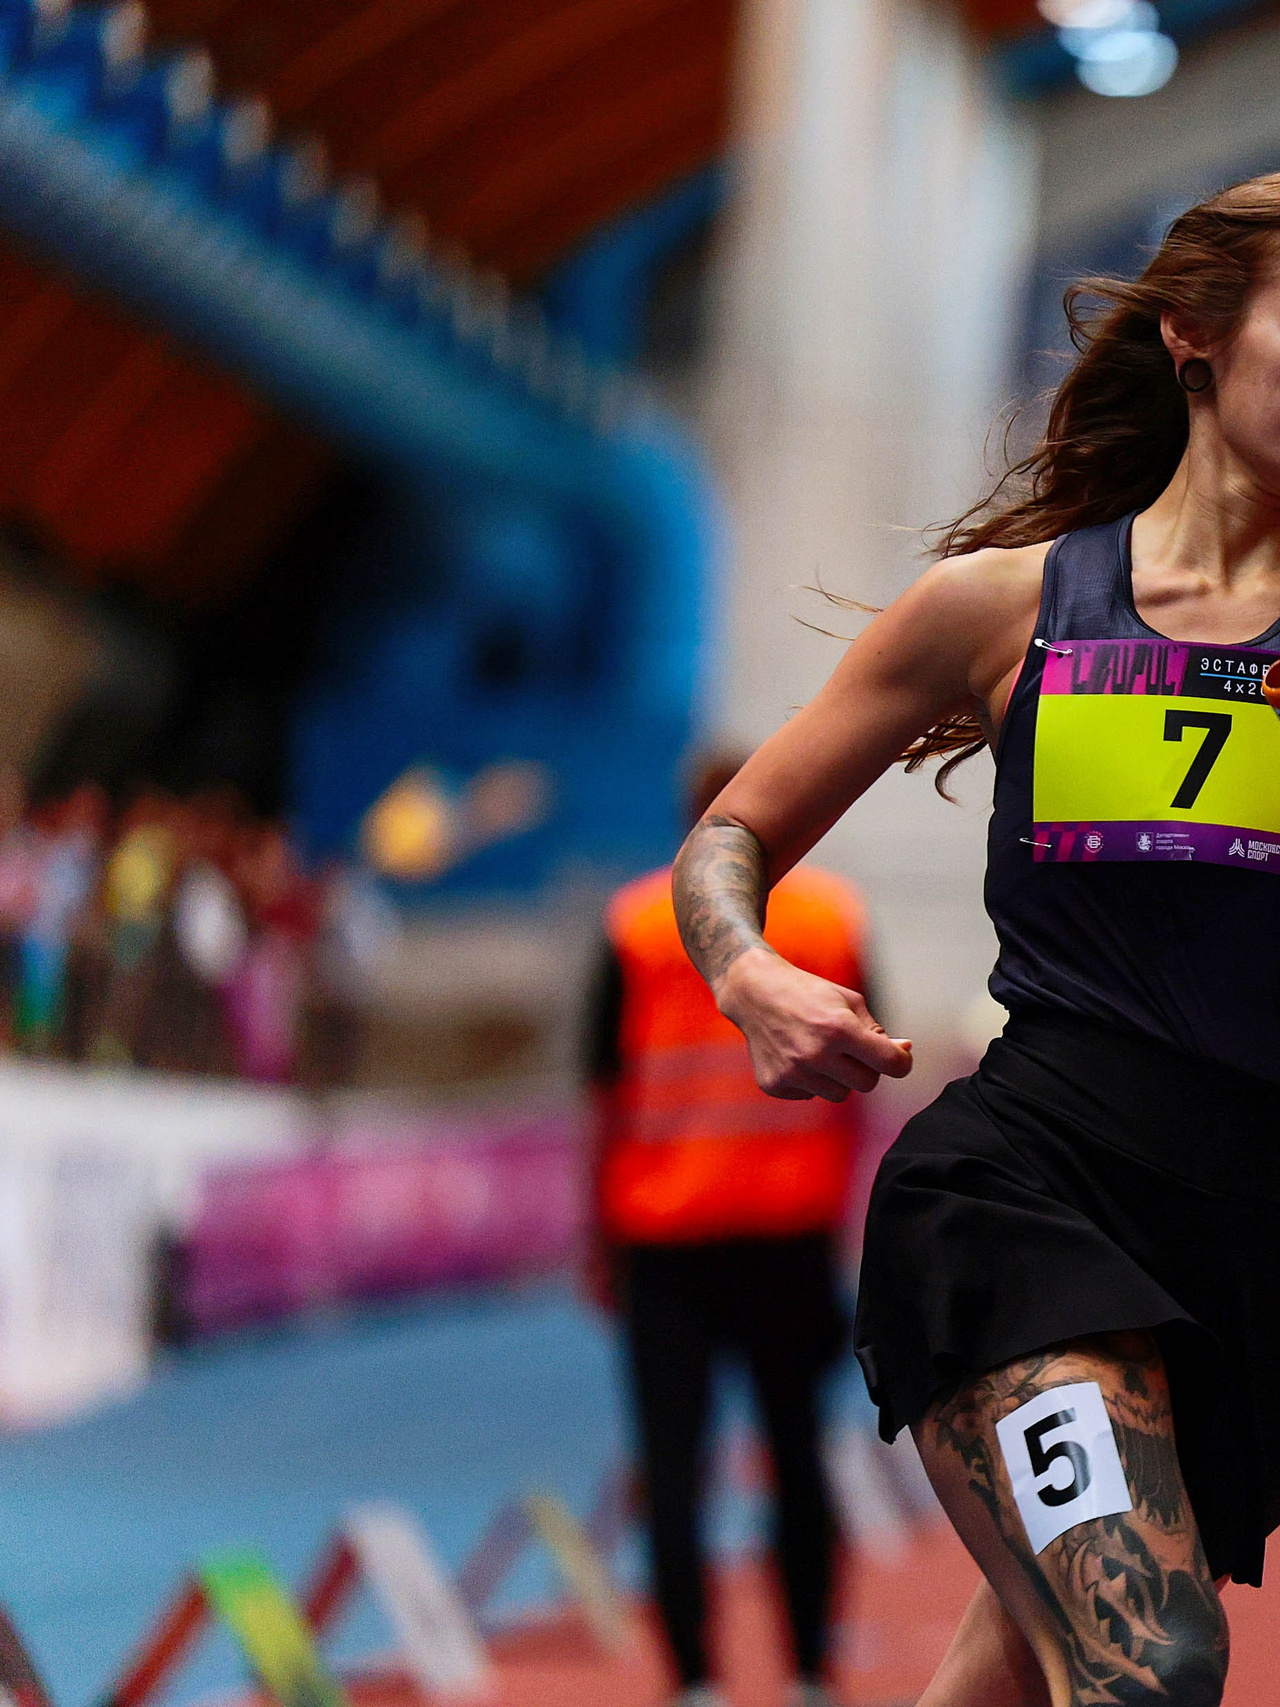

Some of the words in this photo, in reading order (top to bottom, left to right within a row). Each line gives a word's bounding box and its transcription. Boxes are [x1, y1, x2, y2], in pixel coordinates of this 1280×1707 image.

[1223, 680, 1266, 697] 4x2
[1163, 709, 1233, 809] 7
[1247, 849, 1270, 862] СПОРТ
[1023, 1406, 1093, 1508] 5
